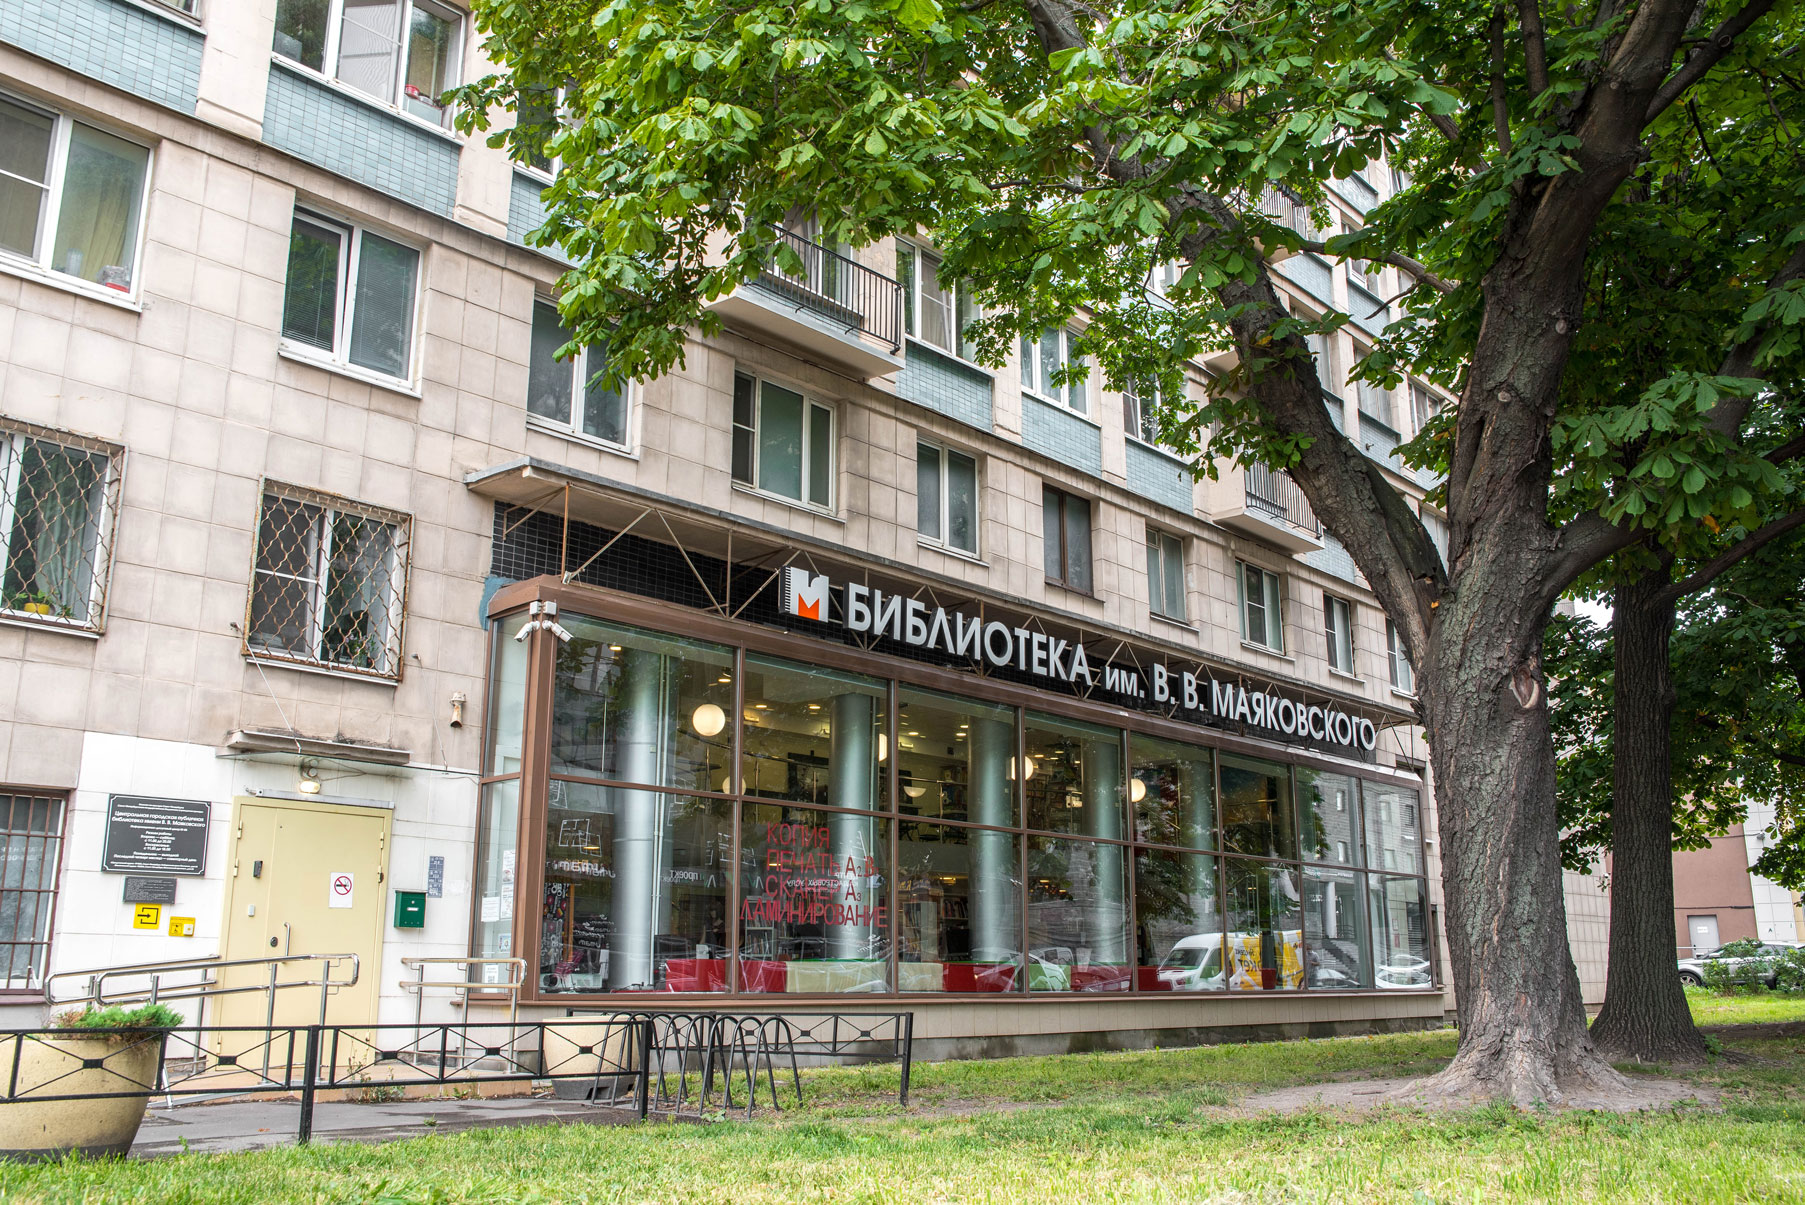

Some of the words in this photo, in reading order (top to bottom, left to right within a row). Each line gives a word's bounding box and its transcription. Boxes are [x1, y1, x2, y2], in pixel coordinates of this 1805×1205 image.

[845, 582, 1092, 686] БИБЛИОТЕКА
[1152, 662, 1176, 705] В.
[1182, 671, 1204, 712] В.
[1210, 679, 1376, 751] МАЯКОВСКОГО
[767, 822, 830, 849] КОПИЯ
[766, 849, 840, 875] ПЕЧАТЬ
[765, 874, 841, 901] СКАНЕР
[740, 898, 888, 928] ЛАМИНИРОВАНИЕ
